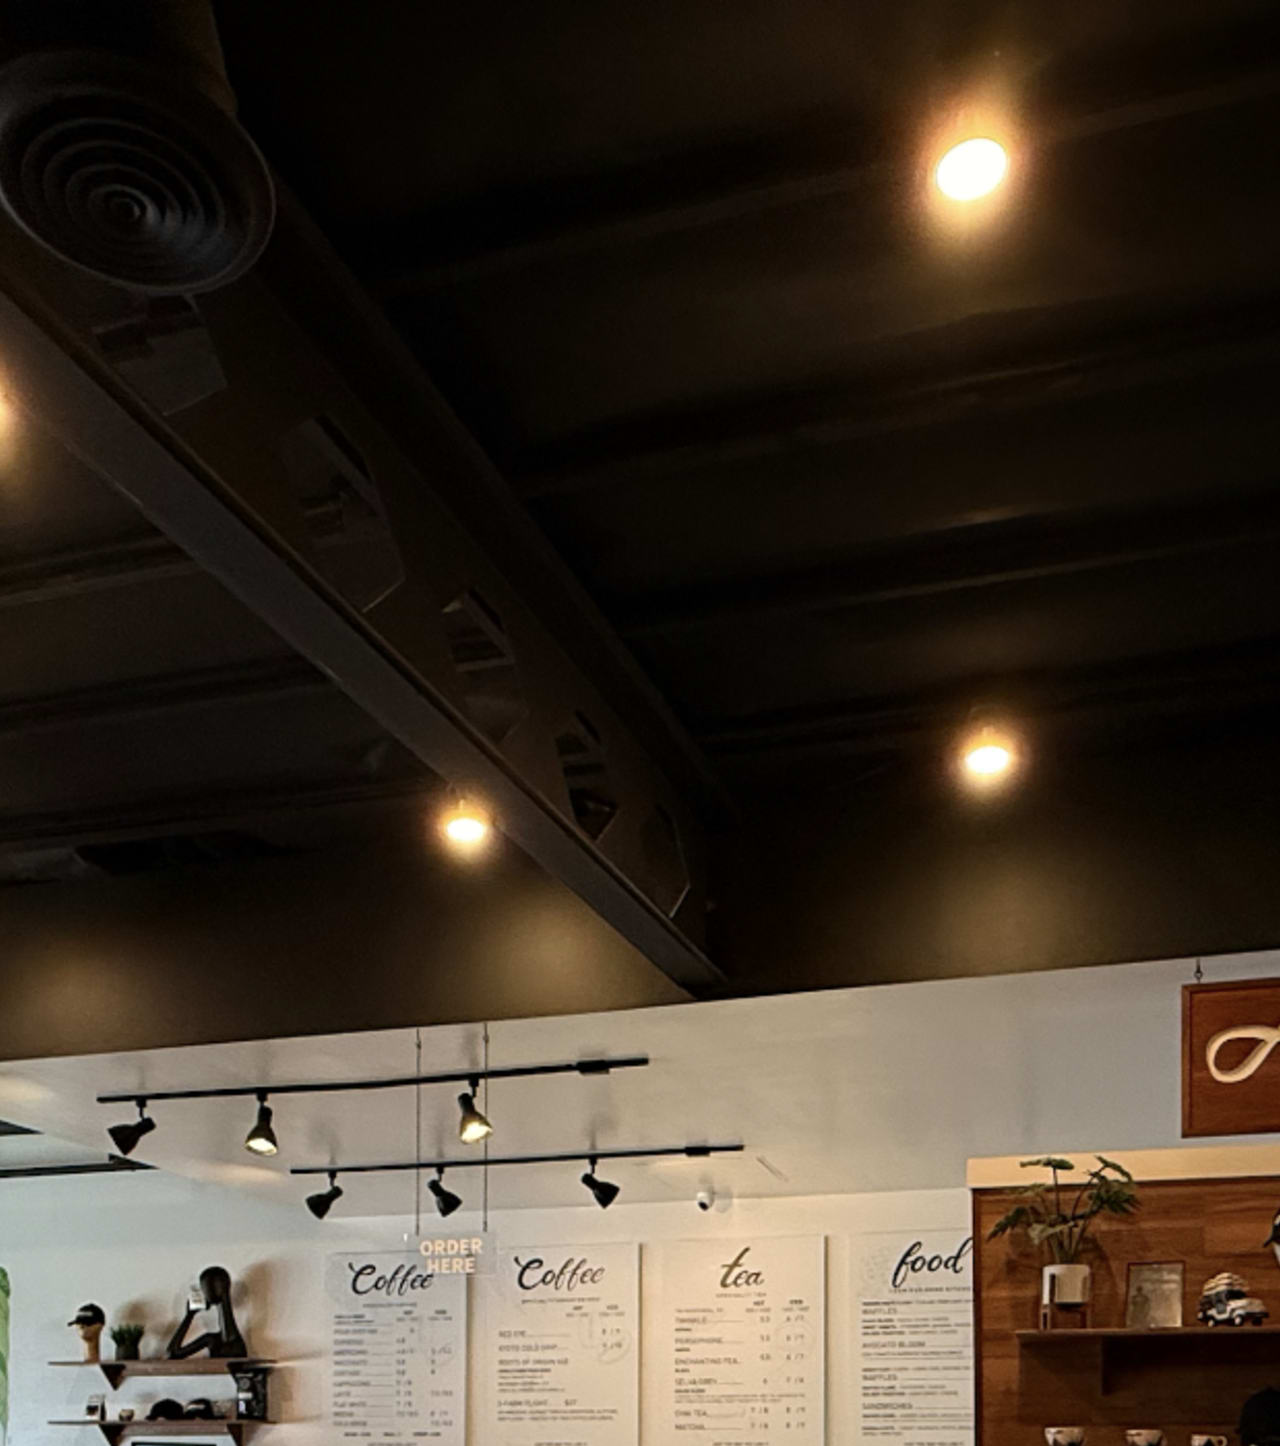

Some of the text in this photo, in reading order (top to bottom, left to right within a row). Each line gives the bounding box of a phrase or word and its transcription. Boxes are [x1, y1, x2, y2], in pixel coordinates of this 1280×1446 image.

[419, 1237, 483, 1256] ORDER
[890, 1236, 973, 1289] food
[348, 1261, 435, 1297] Coffee
[426, 1257, 476, 1274] HERE
[513, 1255, 606, 1292] Coffee
[719, 1246, 766, 1289] tea
